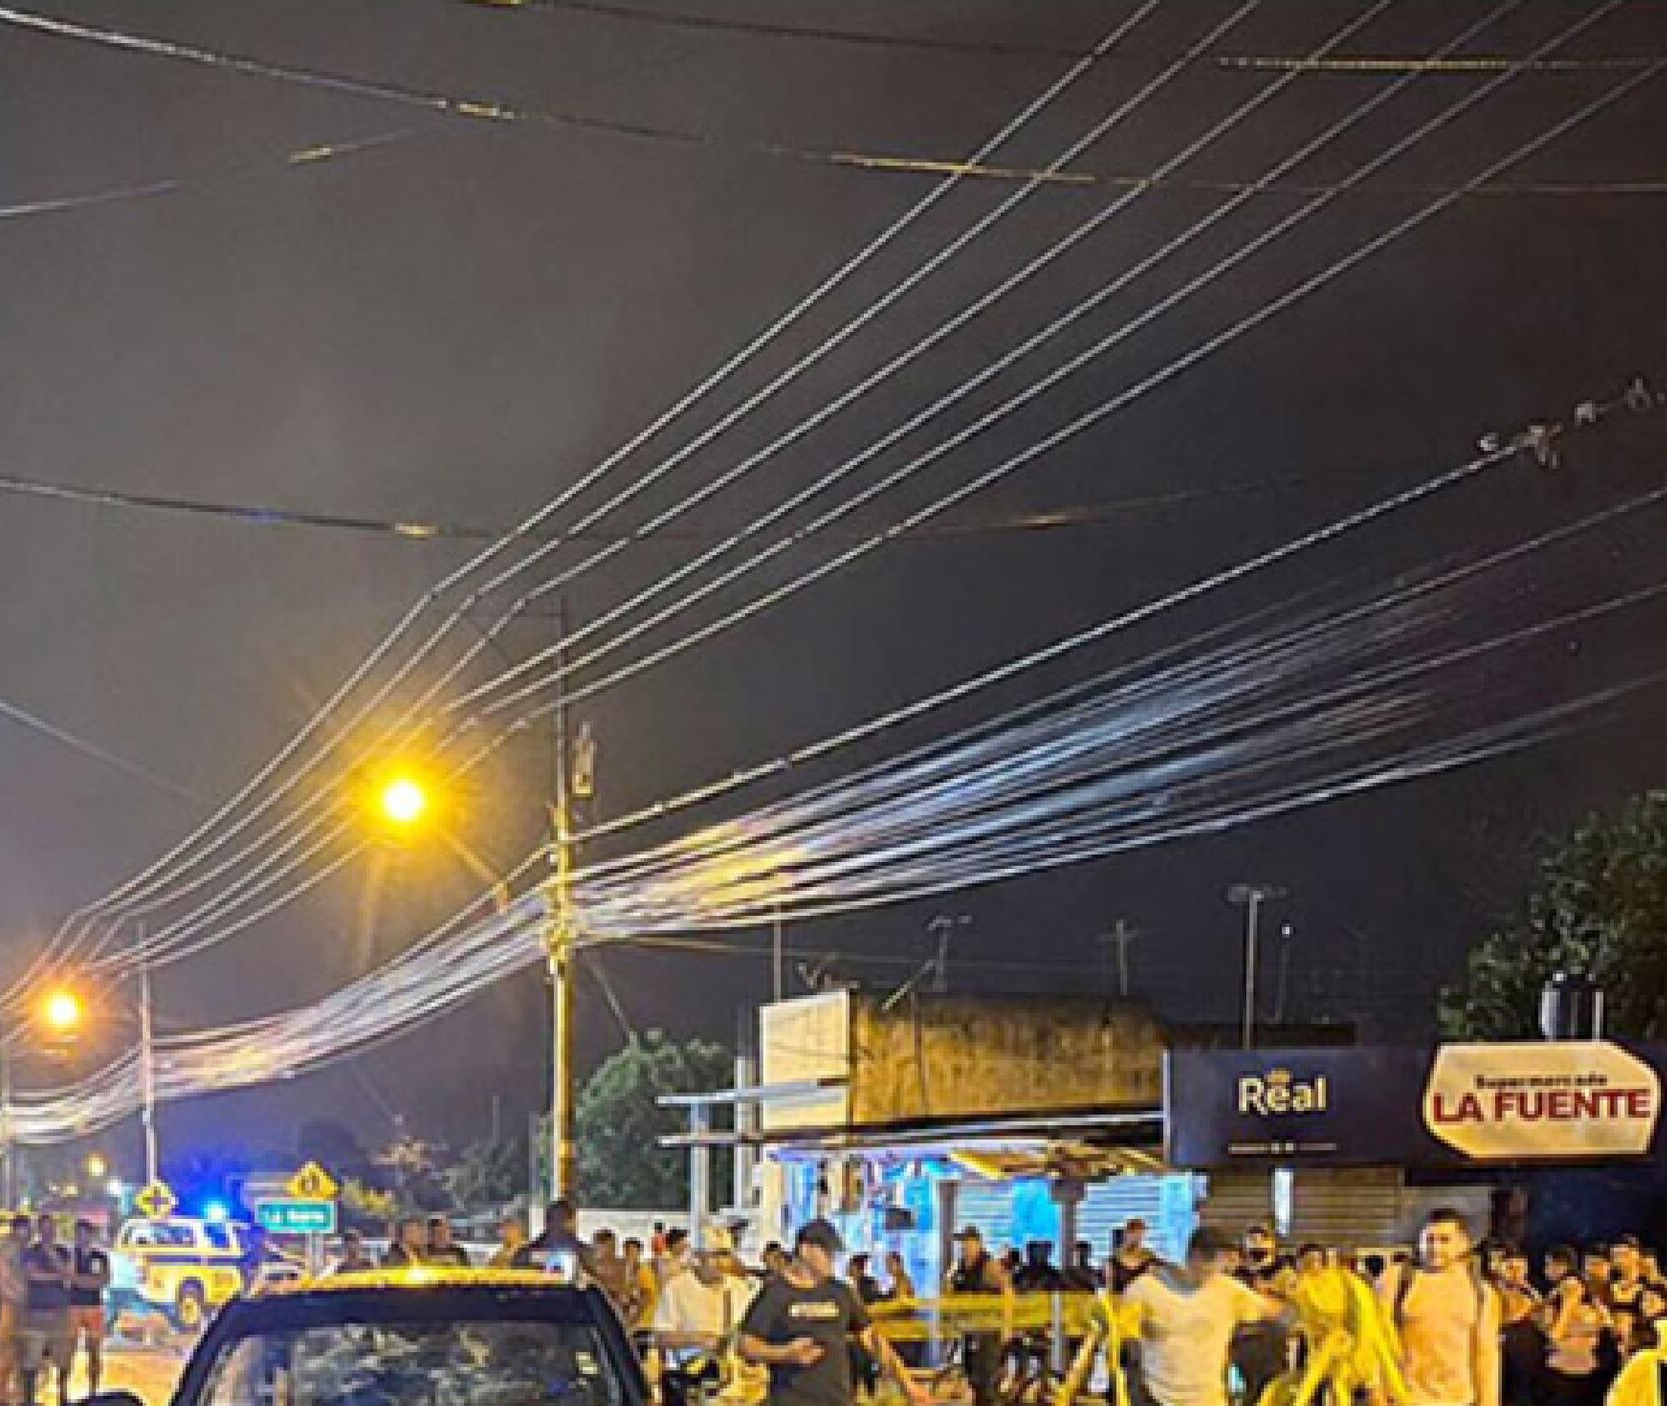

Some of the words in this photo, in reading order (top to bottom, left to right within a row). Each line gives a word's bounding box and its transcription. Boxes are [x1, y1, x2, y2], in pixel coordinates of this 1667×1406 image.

[1238, 1074, 1327, 1116] Real
[1433, 1092, 1484, 1124] LA
[1494, 1087, 1651, 1122] FUENTE
